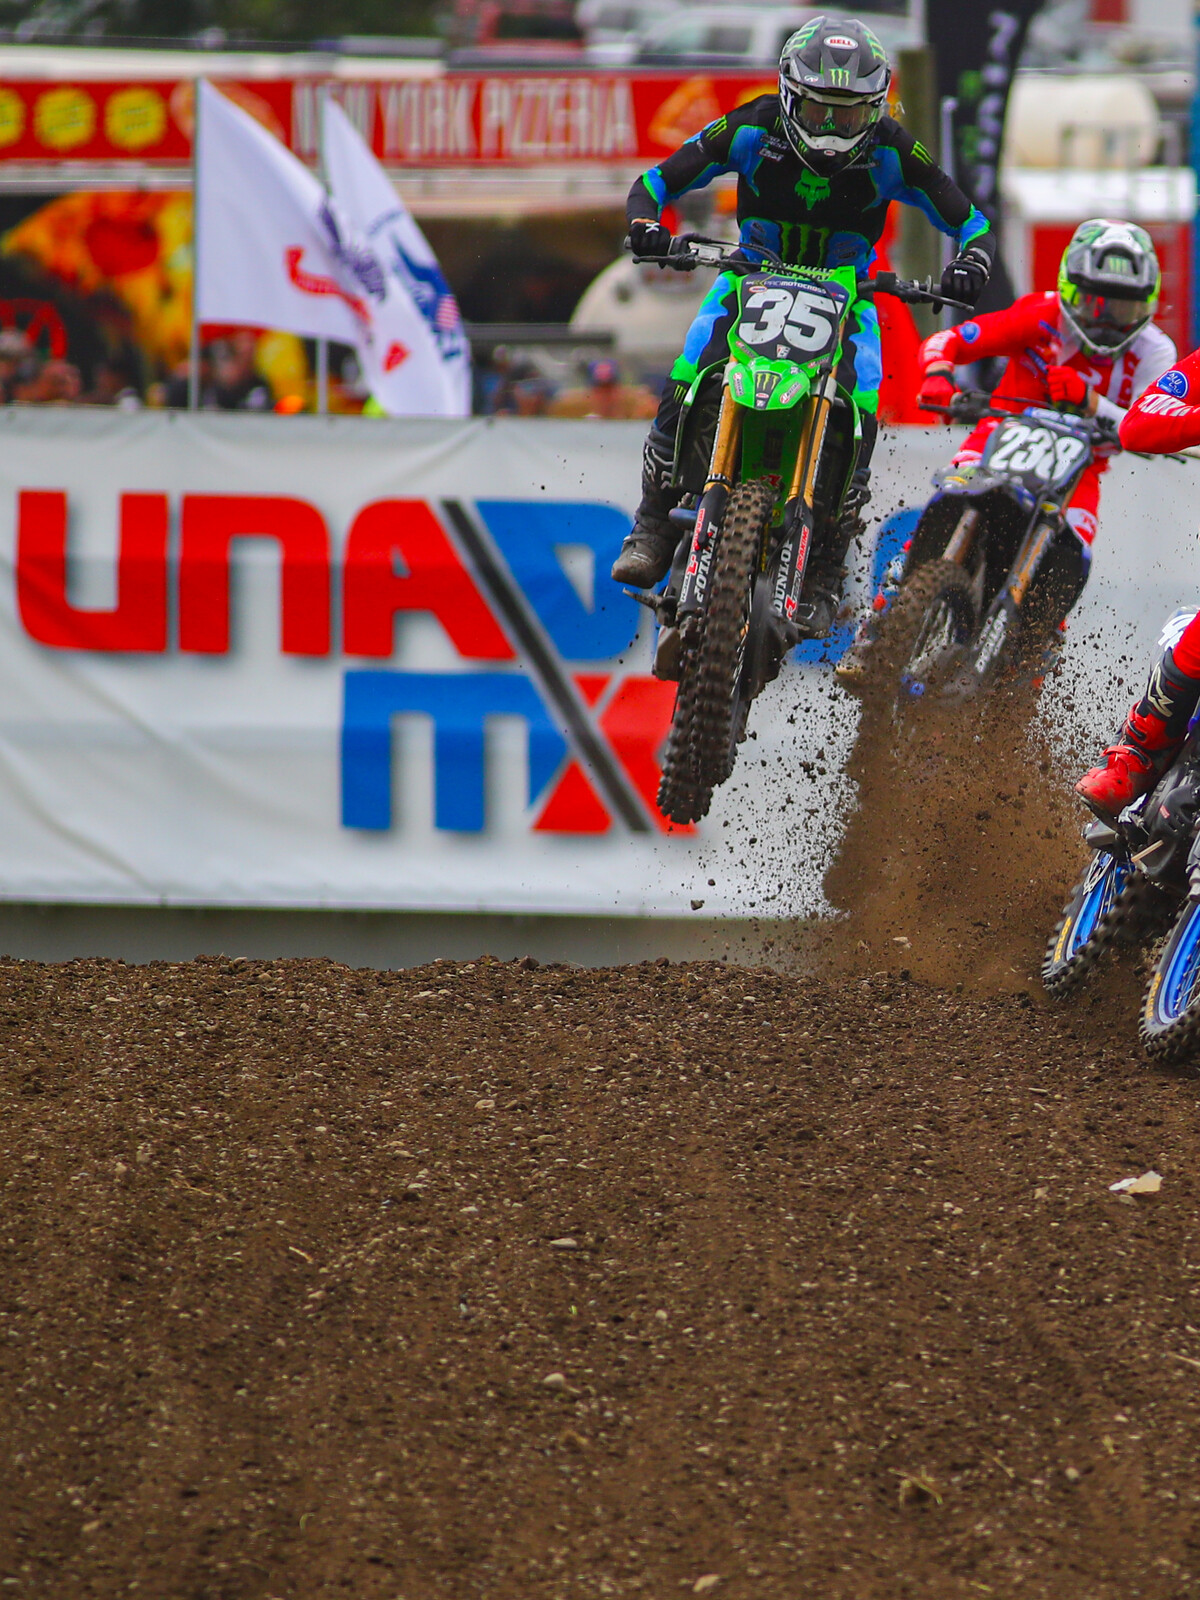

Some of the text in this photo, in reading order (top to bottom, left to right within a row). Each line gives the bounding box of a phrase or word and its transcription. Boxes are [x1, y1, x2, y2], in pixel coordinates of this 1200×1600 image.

[829, 38, 852, 47] BELL
[380, 78, 479, 157] YORK
[481, 78, 638, 157] PIZZERIA
[738, 288, 844, 352] 35
[988, 426, 1085, 481] 238
[796, 524, 811, 573] BRAKING
[341, 668, 697, 836] MX
